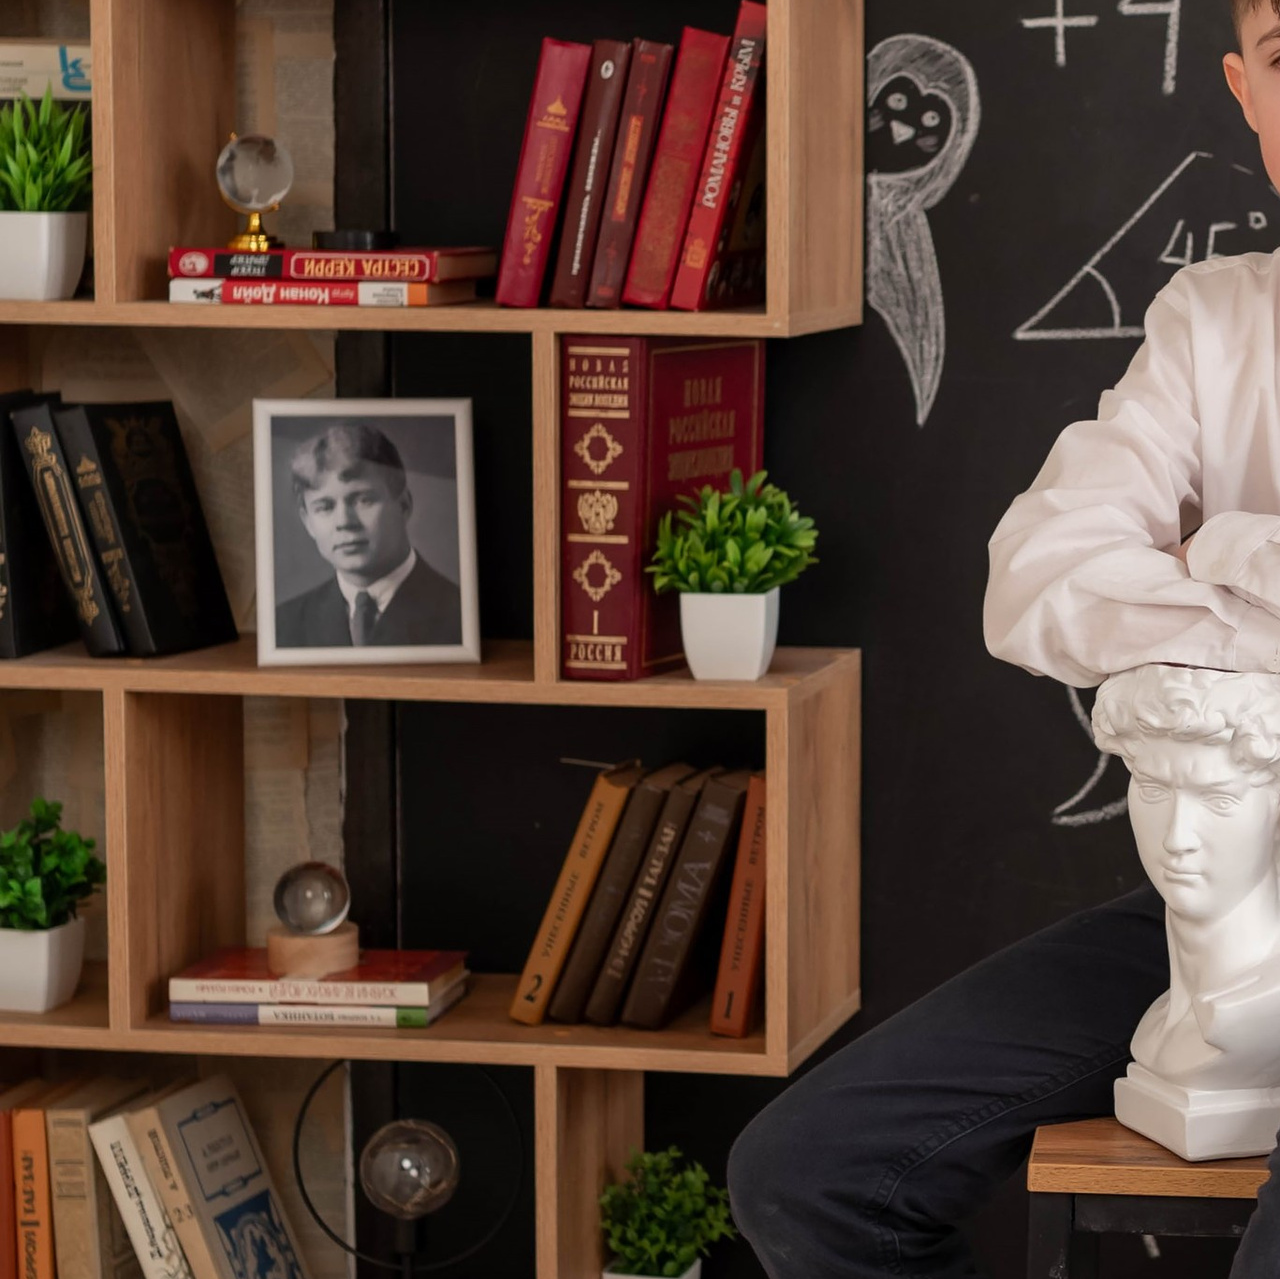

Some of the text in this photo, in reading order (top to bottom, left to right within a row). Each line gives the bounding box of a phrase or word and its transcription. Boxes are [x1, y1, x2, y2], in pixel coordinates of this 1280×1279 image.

[702, 106, 739, 210] РОМАНОВЫ
[731, 38, 757, 93] КРЫМ
[303, 257, 420, 278] СЕСТРА КЕРРИ
[233, 283, 277, 304] Дойл
[279, 286, 330, 302] Конан
[568, 357, 630, 373] НОВАЯ
[568, 374, 630, 391] РОССИЙСКАЯ
[570, 643, 623, 662] РОССИЯ
[748, 806, 767, 866] ВЕТРОМ
[523, 972, 543, 1004] 2
[578, 800, 605, 859] ВЕТРОМ
[272, 1010, 335, 1022] БОТАНИКА
